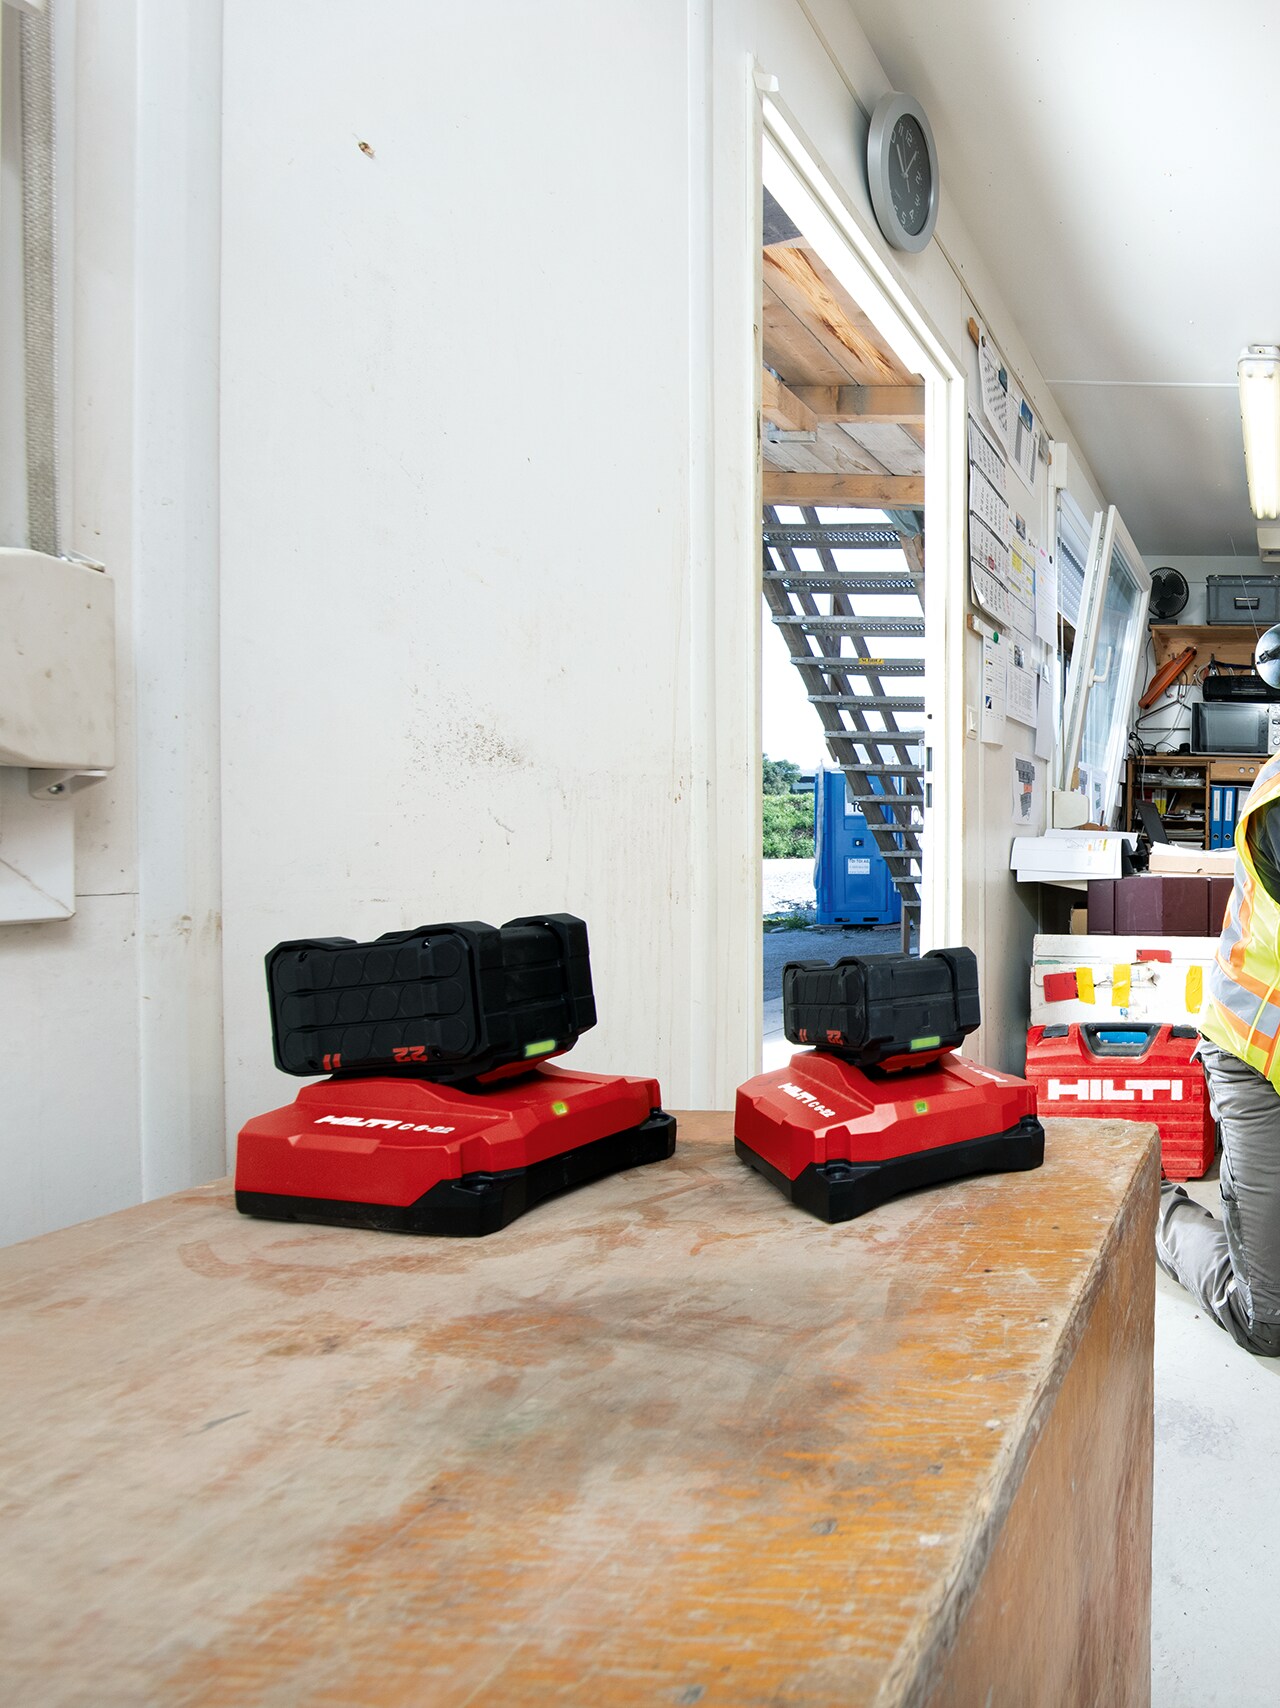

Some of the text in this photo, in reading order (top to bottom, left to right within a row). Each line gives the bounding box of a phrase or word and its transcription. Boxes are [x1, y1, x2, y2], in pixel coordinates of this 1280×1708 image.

[778, 1083, 817, 1103] HILTI
[1047, 1079, 1183, 1101] HILTI
[314, 1115, 402, 1129] HILTI
[413, 1125, 455, 1134] 6-22
